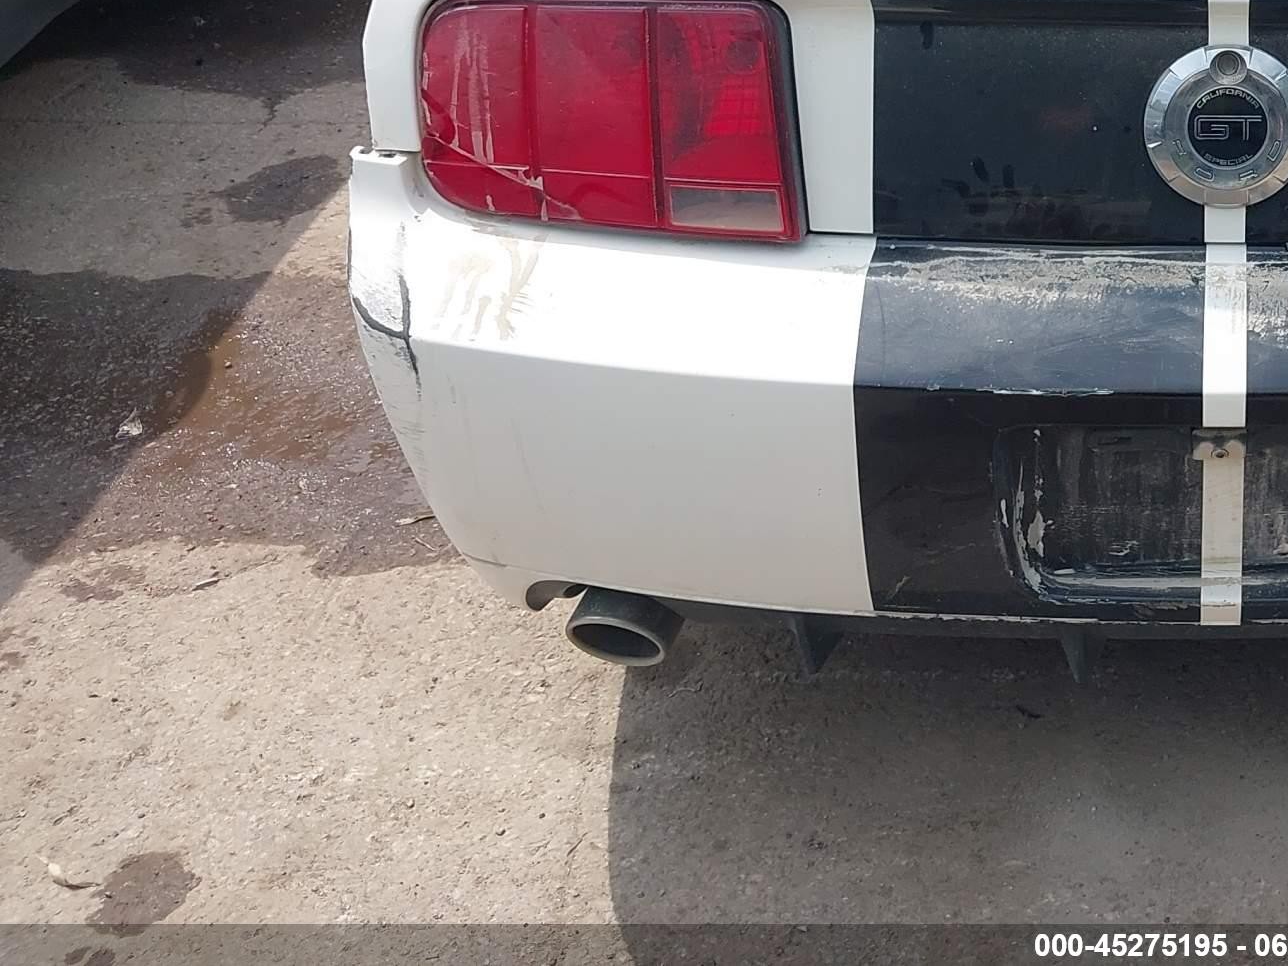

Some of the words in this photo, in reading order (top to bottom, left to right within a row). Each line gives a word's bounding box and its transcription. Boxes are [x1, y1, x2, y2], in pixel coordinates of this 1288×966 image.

[1196, 88, 1260, 109] CALIFORNIA
[1194, 114, 1263, 141] GT
[1203, 153, 1254, 166] SPECIAL
